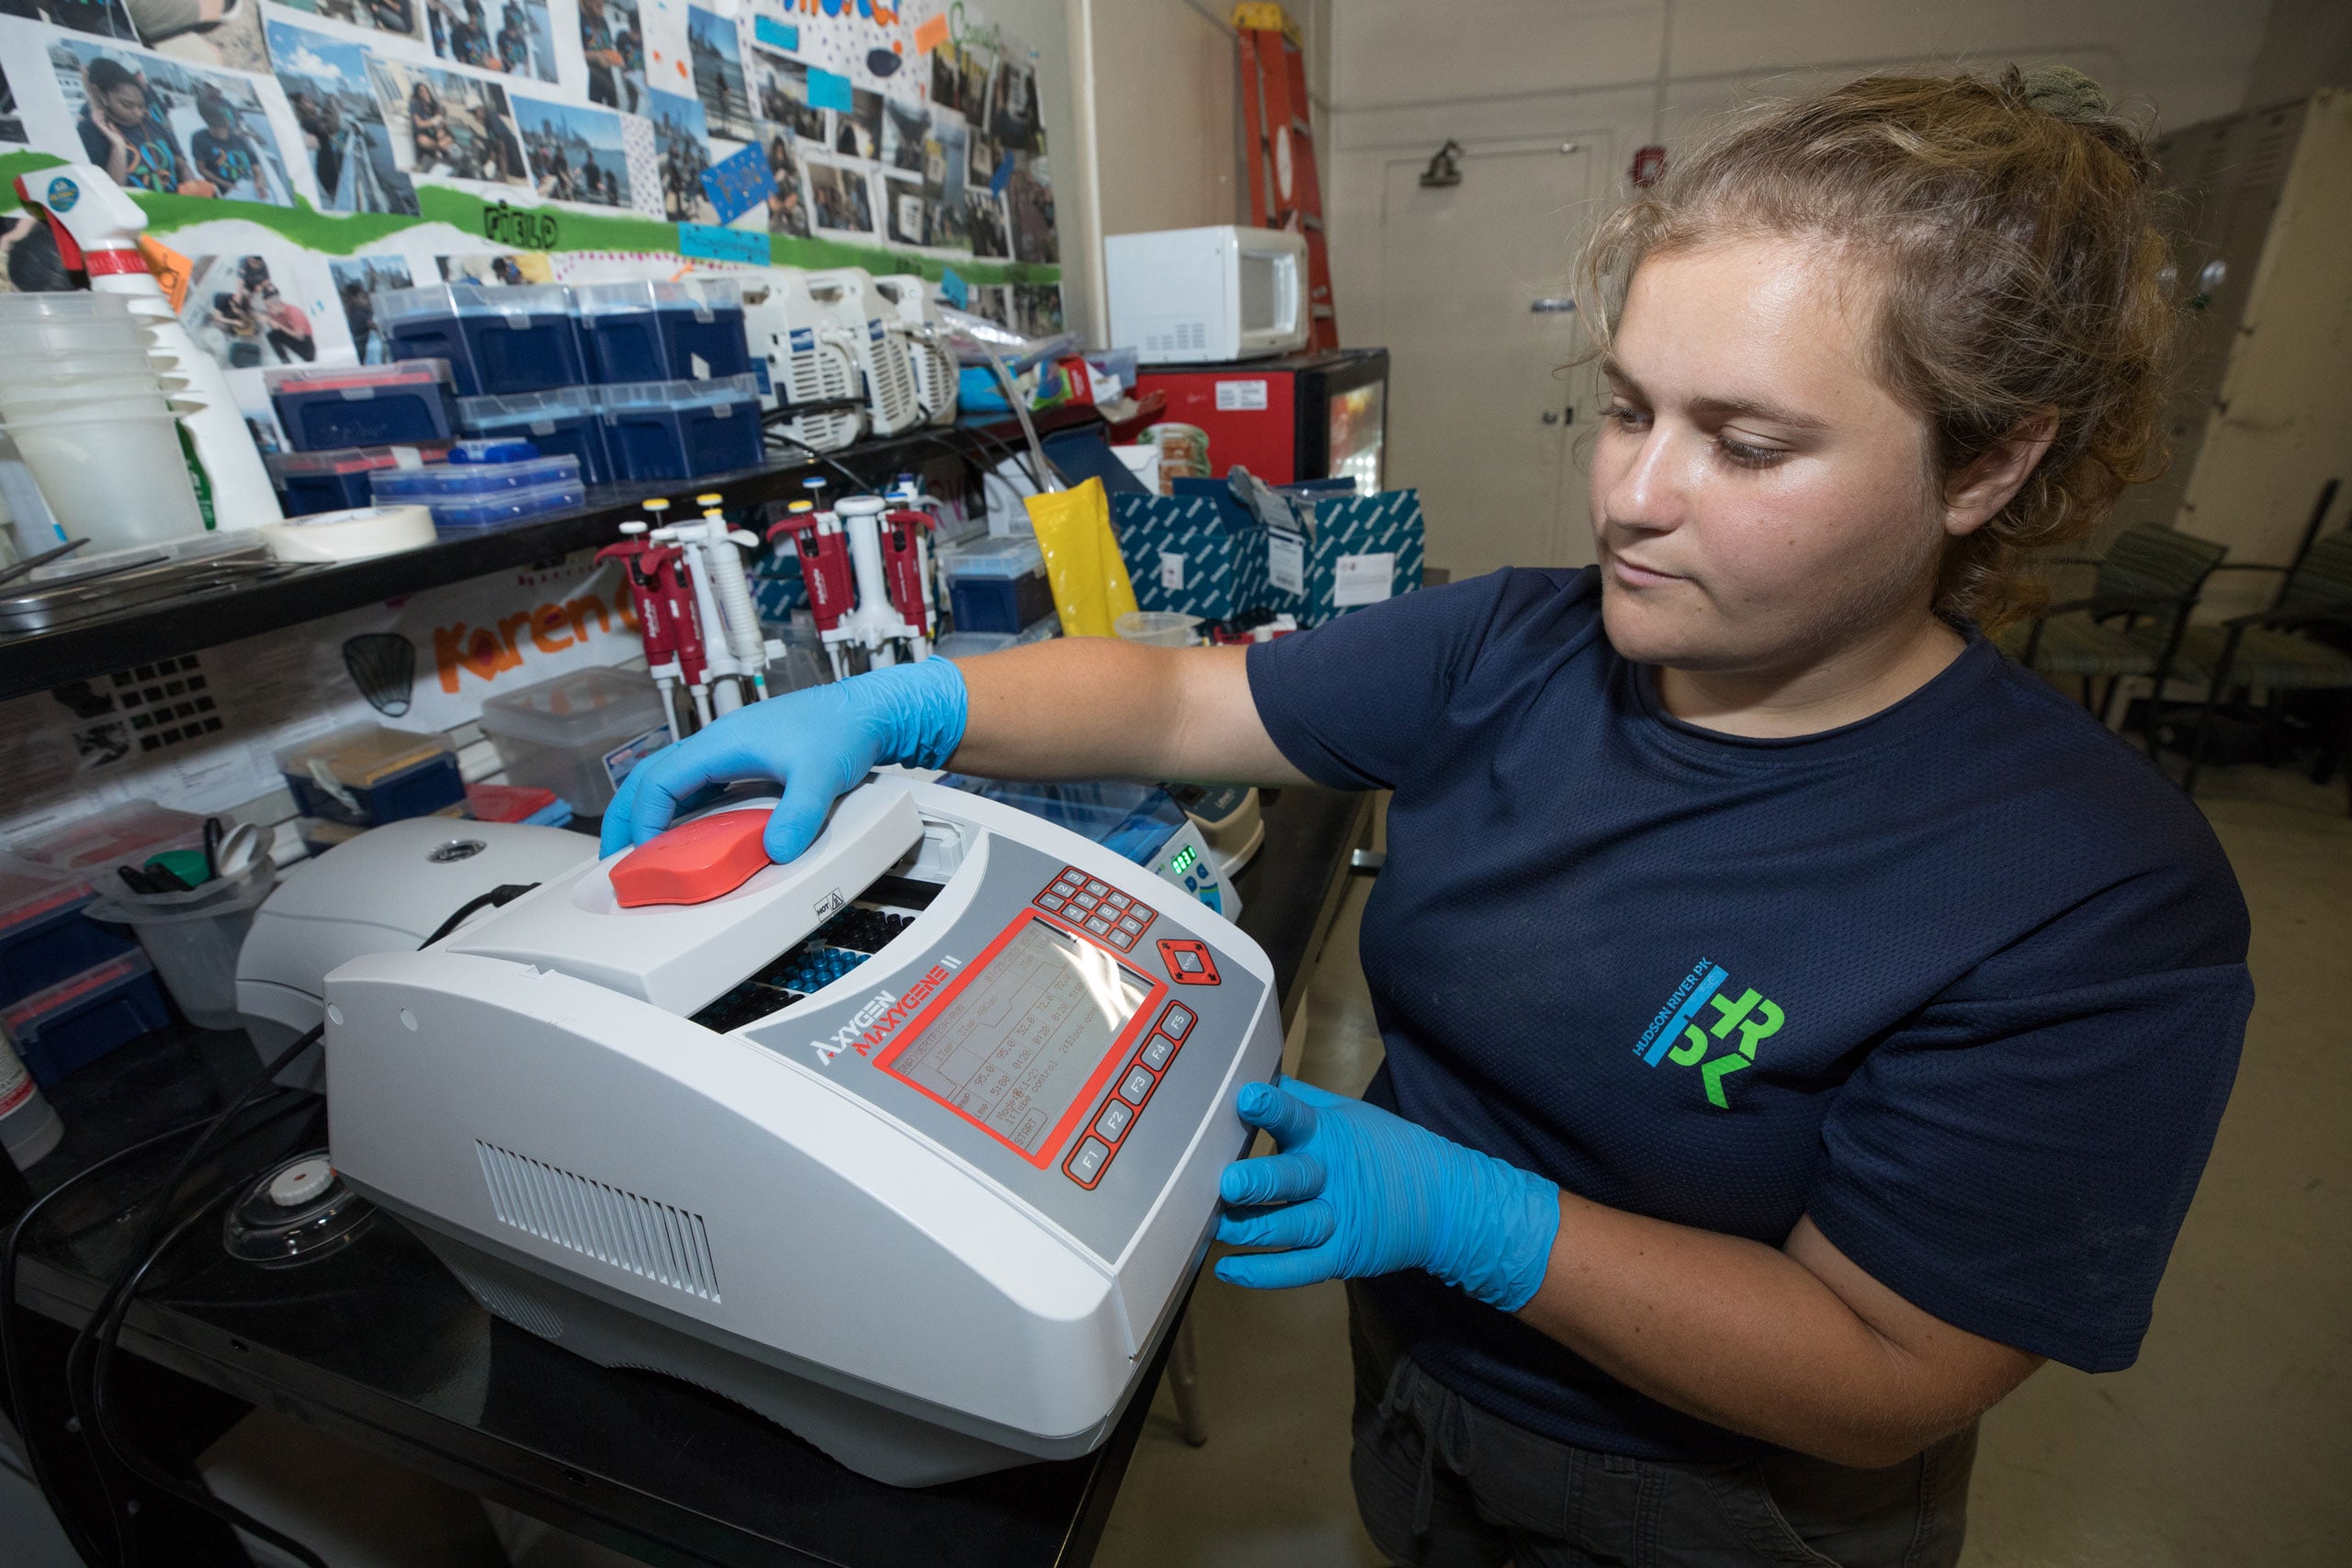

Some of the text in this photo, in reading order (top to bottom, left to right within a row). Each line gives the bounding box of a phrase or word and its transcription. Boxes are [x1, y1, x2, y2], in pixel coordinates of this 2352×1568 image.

[1172, 845, 1197, 875] 0031
[817, 902, 831, 917] HOT
[851, 964, 950, 1057] MAXYGENE
[1632, 956, 1713, 1056] HUDSON RIVER PK
[809, 989, 897, 1066] AXYGEN
[1171, 1015, 1184, 1030] F5
[974, 1065, 995, 1086] 95.0
[996, 1040, 1015, 1059] 95.0
[1016, 1016, 1035, 1034] 52.0
[1152, 1044, 1166, 1060] F4
[1131, 1077, 1146, 1093] F3
[1107, 1111, 1124, 1130] F2
[1082, 1151, 1099, 1169] F1
